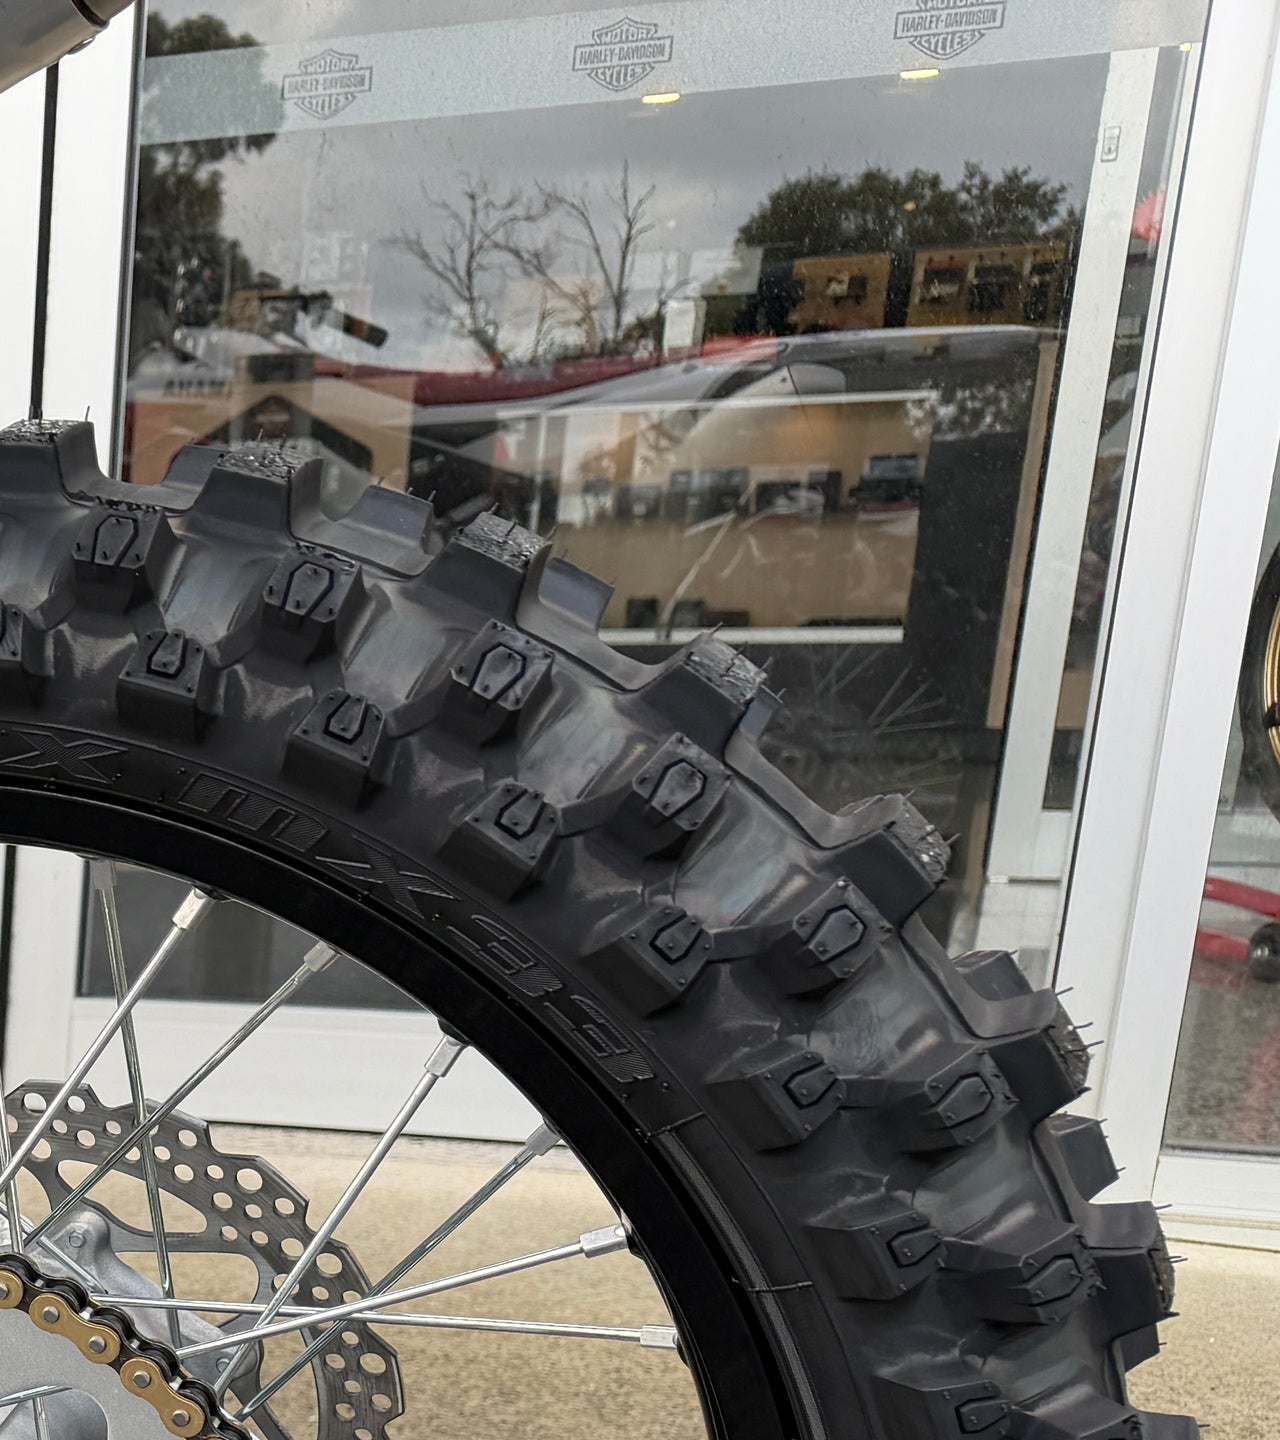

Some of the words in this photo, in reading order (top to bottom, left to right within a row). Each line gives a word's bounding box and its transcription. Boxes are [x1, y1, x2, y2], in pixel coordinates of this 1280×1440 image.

[902, 8, 998, 33] HARLEY-DAVIDSON
[579, 43, 666, 66] HARLEY-DAVIDSON
[920, 30, 975, 55] CYCLES
[177, 772, 655, 1083] MX33
